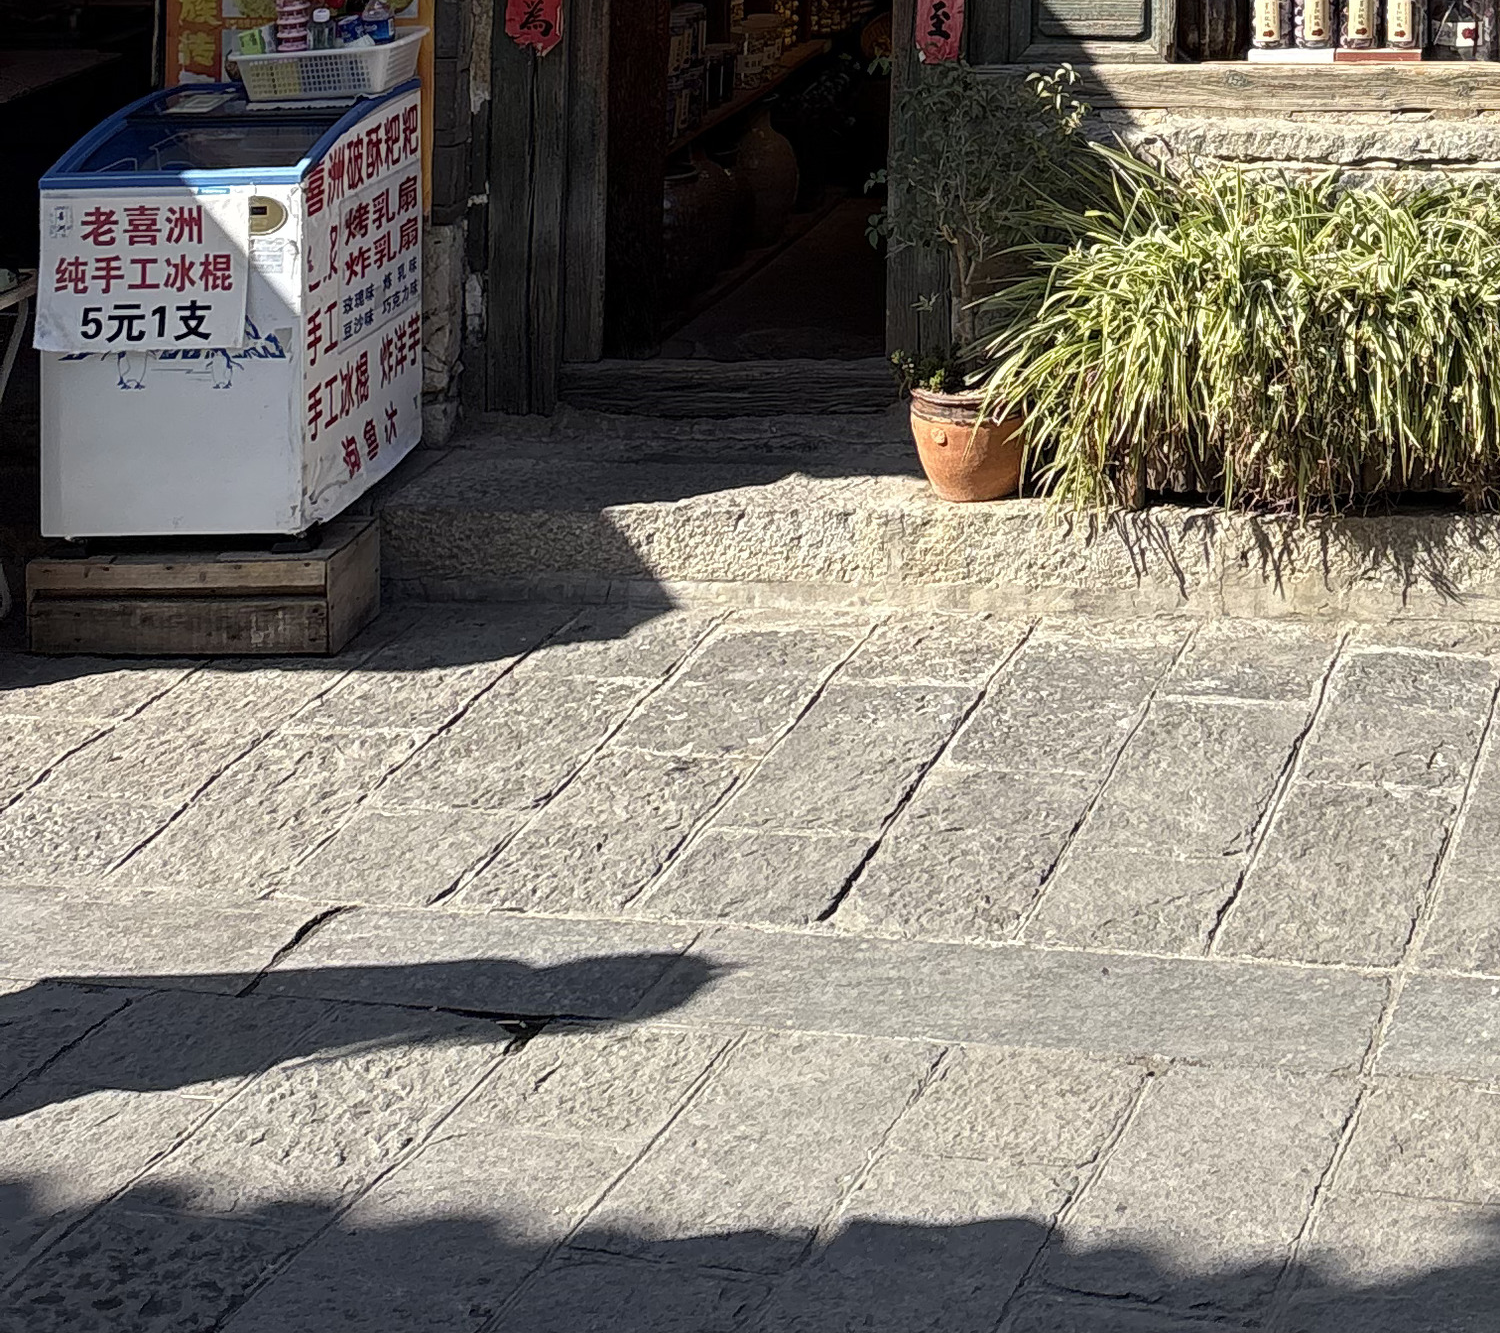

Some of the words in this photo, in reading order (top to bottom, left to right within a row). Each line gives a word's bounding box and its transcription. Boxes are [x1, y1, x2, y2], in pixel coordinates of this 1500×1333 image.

[306, 104, 419, 217] 喜洲破酥粑粑
[80, 205, 204, 246] 老喜洲
[345, 175, 418, 246] 烤乳扇
[54, 254, 234, 294] 纯手工冰棍
[345, 215, 419, 286] 炸乳扇
[80, 299, 212, 342] 5元1支
[342, 283, 375, 315] 玫瑰味
[382, 279, 419, 315] 巧克力味
[307, 300, 338, 366] 手工
[343, 308, 374, 341] 豆沙味
[380, 311, 420, 389] 炸洋芋
[307, 350, 370, 441] 手工冰棍
